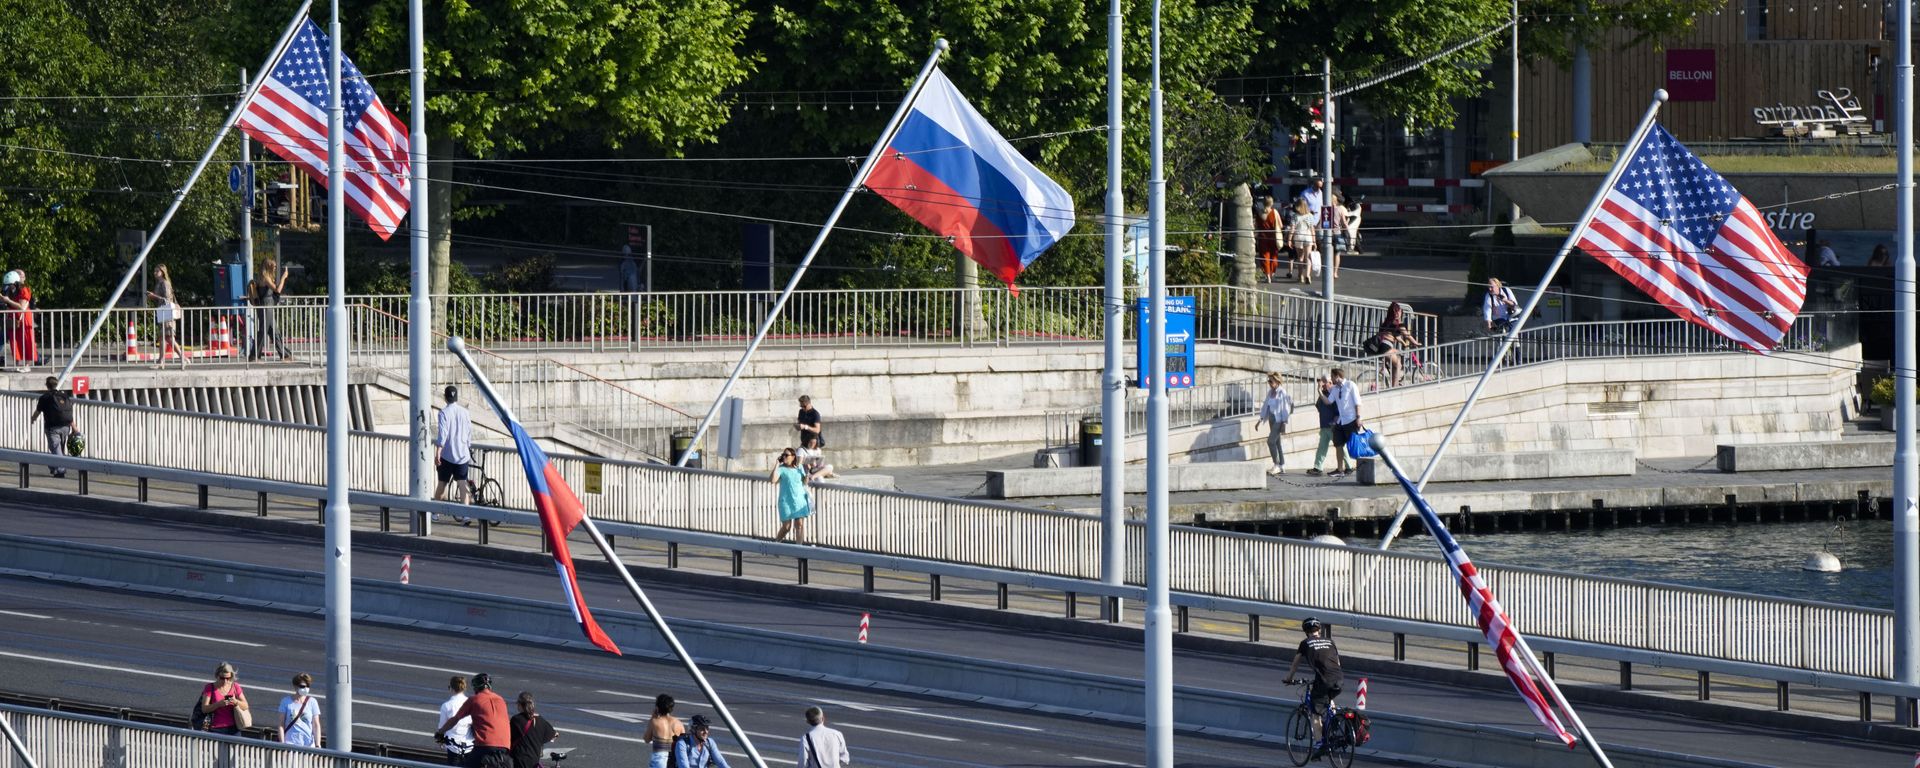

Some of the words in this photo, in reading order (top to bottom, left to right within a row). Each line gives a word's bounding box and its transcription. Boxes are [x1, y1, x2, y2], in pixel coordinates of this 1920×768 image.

[1669, 71, 1713, 80] BELLONI
[1762, 208, 1815, 230] stre
[77, 380, 85, 391] F
